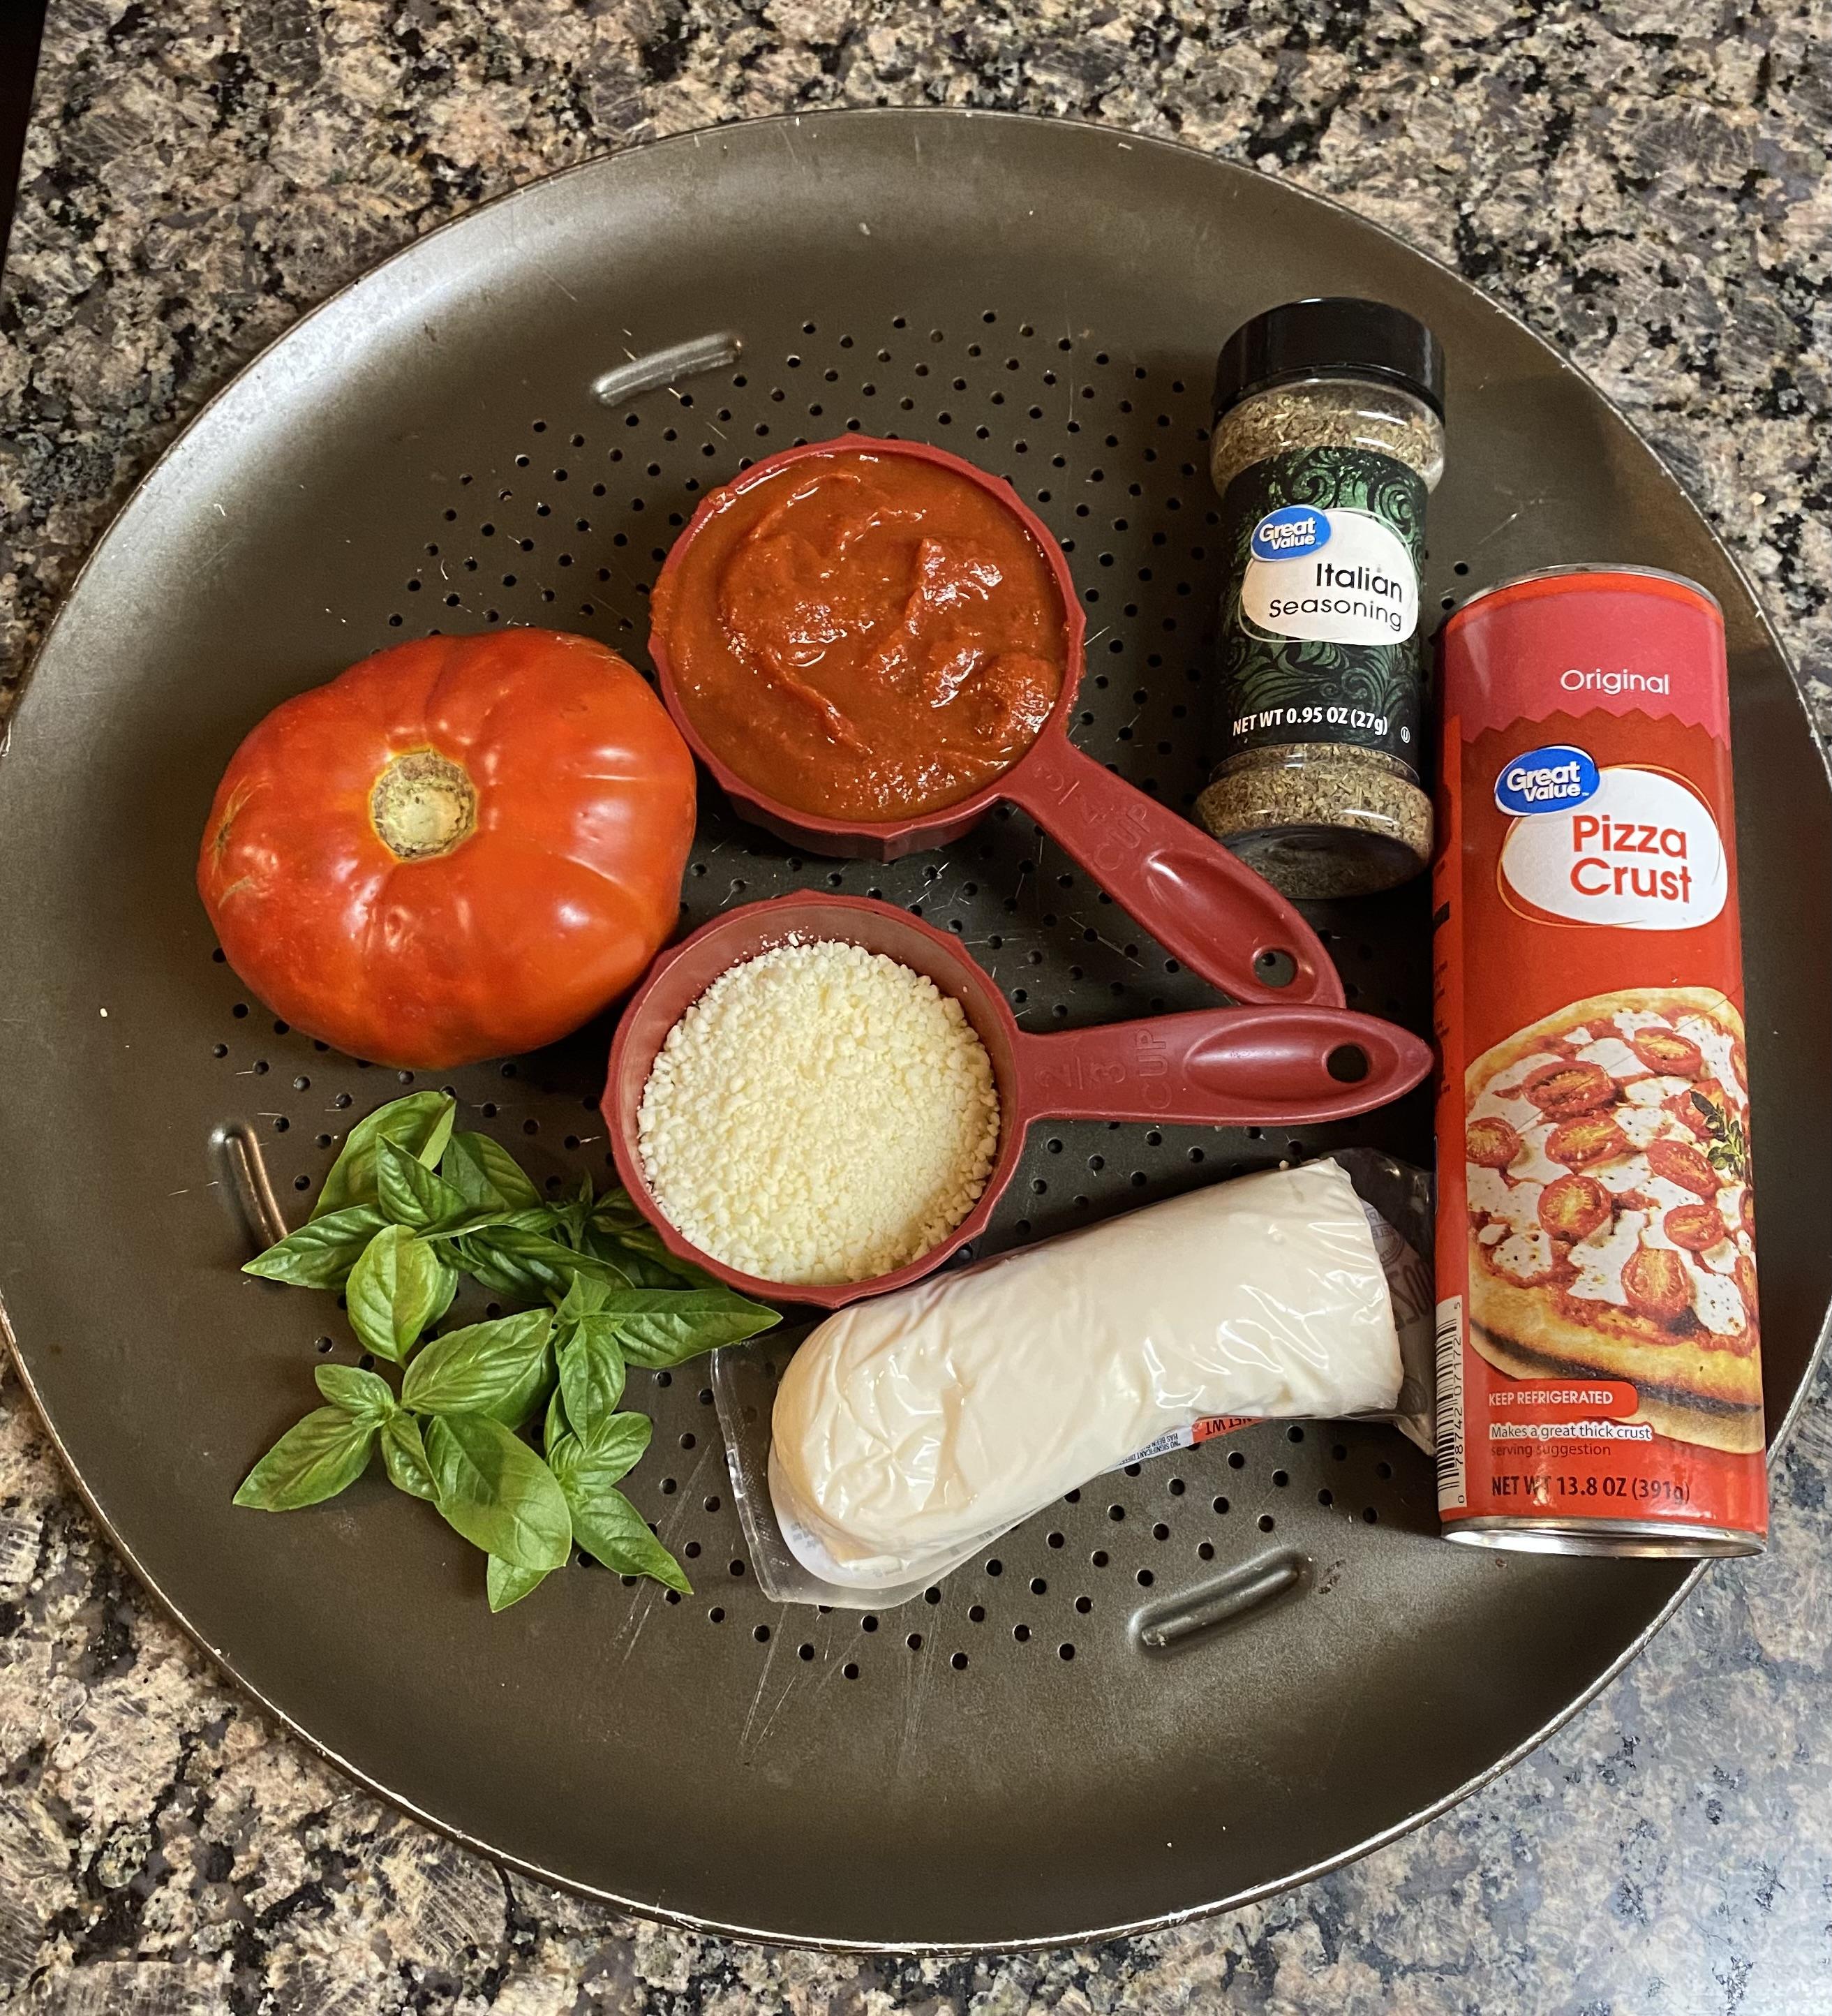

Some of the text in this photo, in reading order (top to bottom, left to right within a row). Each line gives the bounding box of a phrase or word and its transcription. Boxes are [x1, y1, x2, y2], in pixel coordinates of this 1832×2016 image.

[1260, 517, 1316, 542] Great
[1271, 535, 1316, 550] Value
[1316, 563, 1403, 602] Italian
[1269, 599, 1402, 631] Seasoning
[1561, 668, 1669, 695] Original
[1232, 707, 1387, 736] NET WT 0.95 OZ (27g)
[1507, 761, 1580, 791] Great
[1524, 783, 1581, 802] Value
[1094, 803, 1150, 871] CUP
[1572, 815, 1688, 860] Pizza
[1570, 857, 1692, 903] Crust
[1135, 1030, 1172, 1109] CUP
[1453, 1336, 1462, 1396] 07172
[1489, 1391, 1613, 1407] KEEP REFRIGERATED
[1454, 1407, 1464, 1465] 78742
[1491, 1424, 1651, 1441] Makes a great thick crust
[1491, 1443, 1611, 1458] serving suggestion
[1491, 1476, 1690, 1505] NET WT 13.8 OZ (391g)
